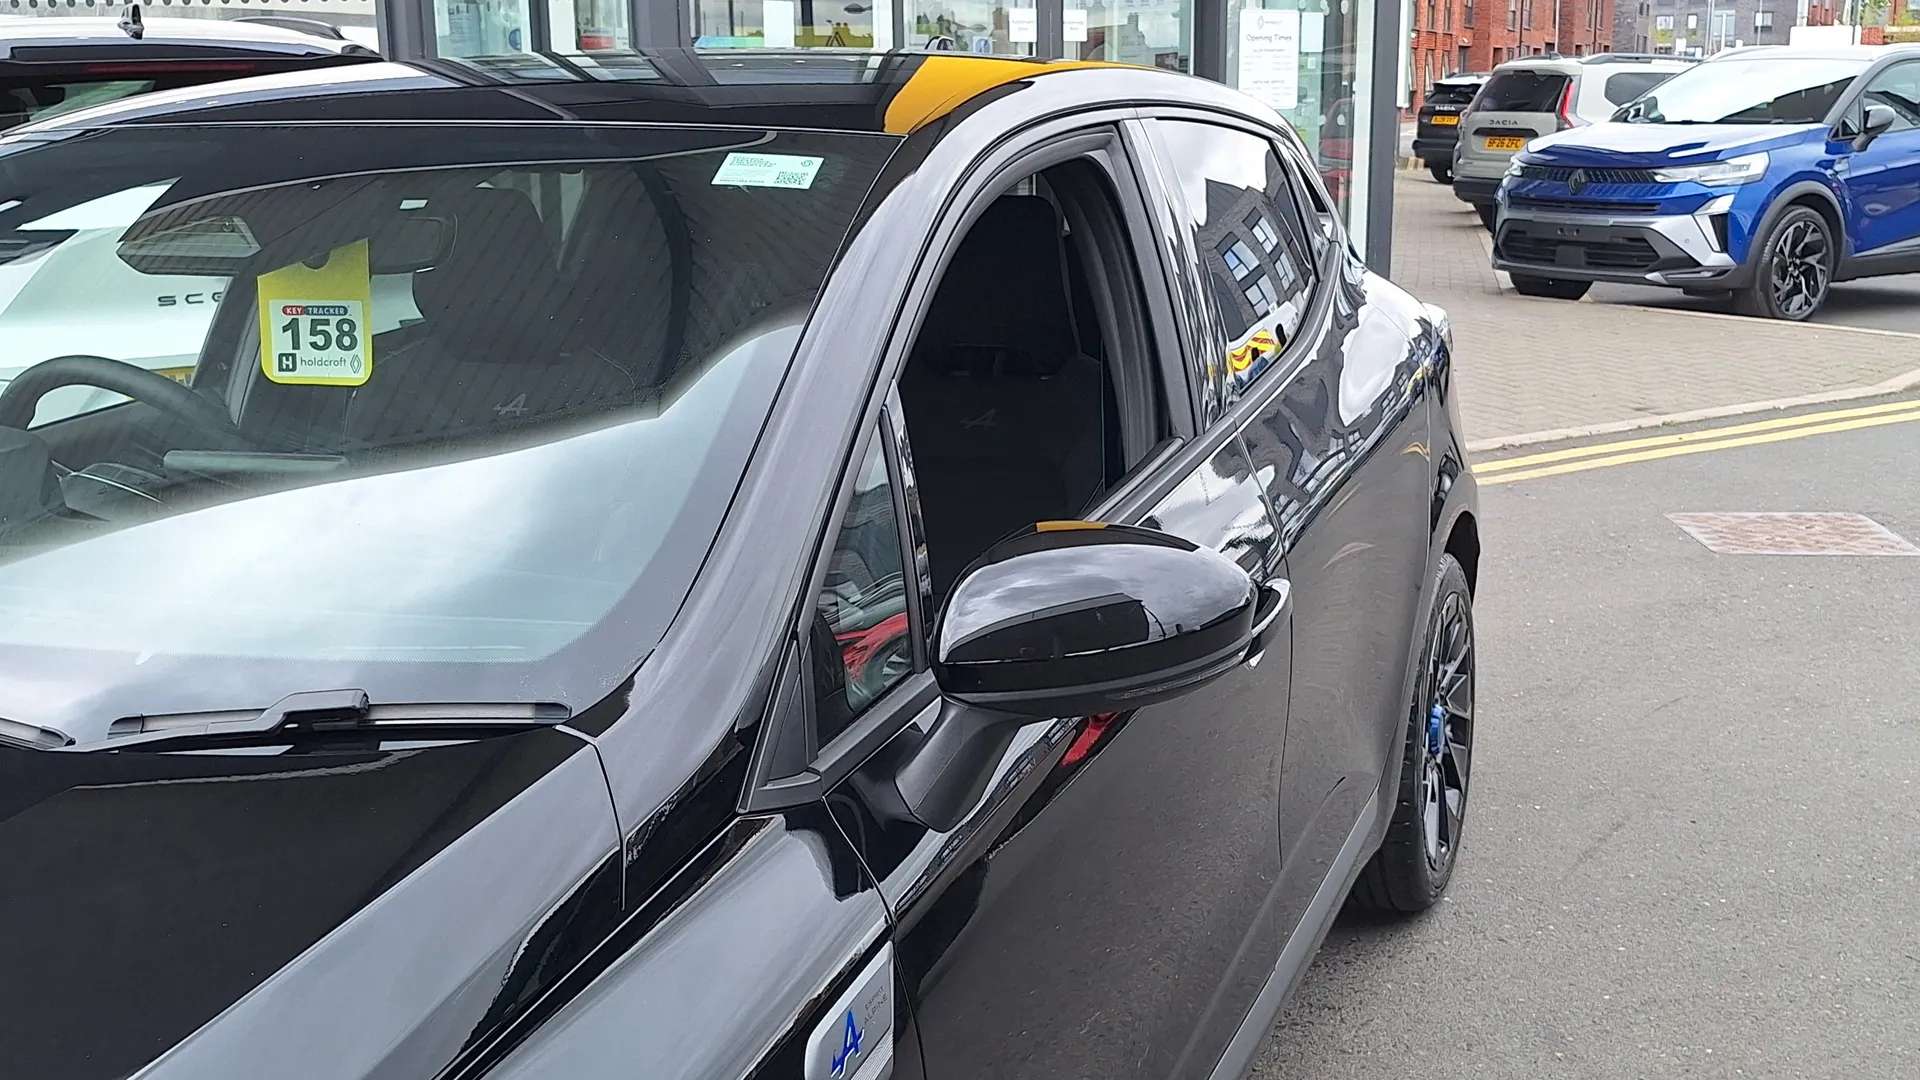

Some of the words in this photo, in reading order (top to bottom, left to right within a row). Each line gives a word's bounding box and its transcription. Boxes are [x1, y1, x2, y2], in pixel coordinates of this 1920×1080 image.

[1246, 33, 1273, 42] Opening
[1274, 33, 1292, 41] Times
[286, 307, 301, 315] KEY
[308, 307, 345, 315] TRACKER
[282, 318, 358, 351] 158
[300, 356, 347, 367] holdcroft
